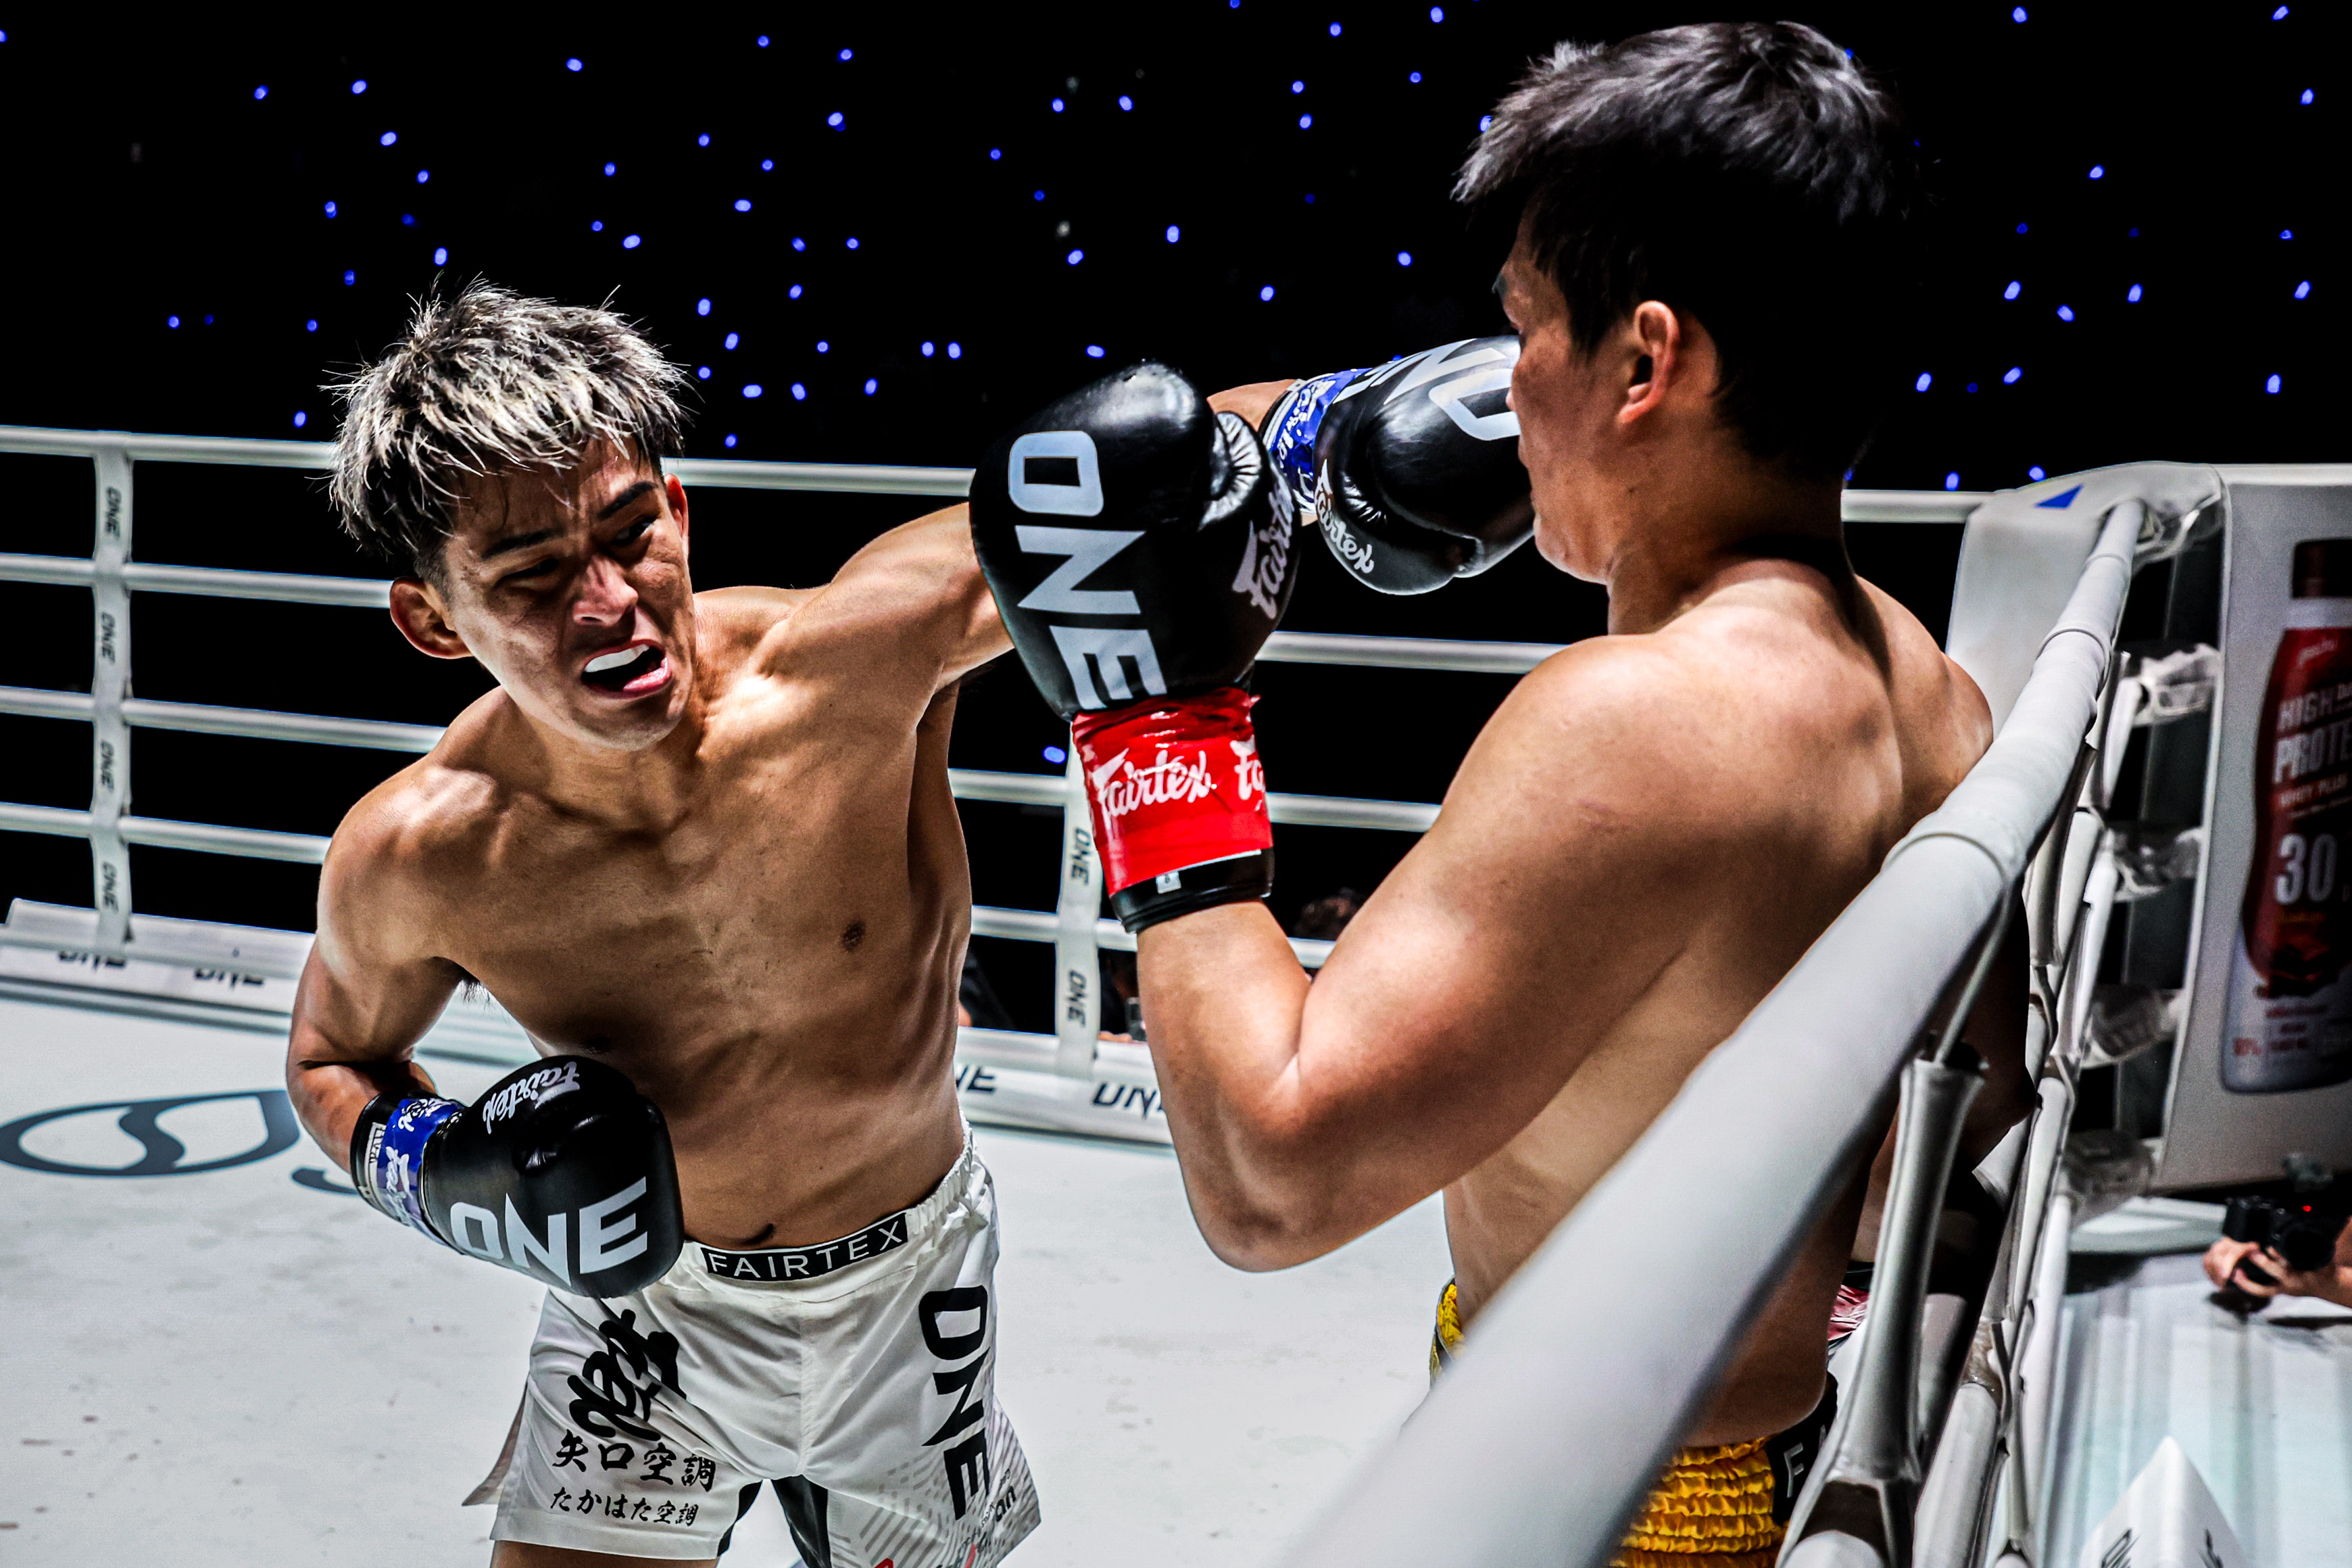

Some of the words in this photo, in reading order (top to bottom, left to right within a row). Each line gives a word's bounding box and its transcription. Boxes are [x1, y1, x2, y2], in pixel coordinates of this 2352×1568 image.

[105, 486, 122, 539] ONE
[1314, 459, 1374, 573] Fairtex
[1008, 431, 1167, 710] ONE
[101, 612, 116, 665] ONE
[100, 739, 114, 792] ONE
[1092, 748, 1212, 819] Fairtex
[1071, 827, 1091, 885] ONE
[102, 862, 119, 914] ONE
[1067, 970, 1087, 1028] ONE
[483, 1061, 580, 1134] Fairtex
[450, 1176, 647, 1287] ONE
[708, 1220, 903, 1278] FAIRTEX
[919, 1285, 991, 1521] ONE
[552, 1429, 716, 1492] 矢口空調
[549, 1487, 699, 1527] たかはた空調
